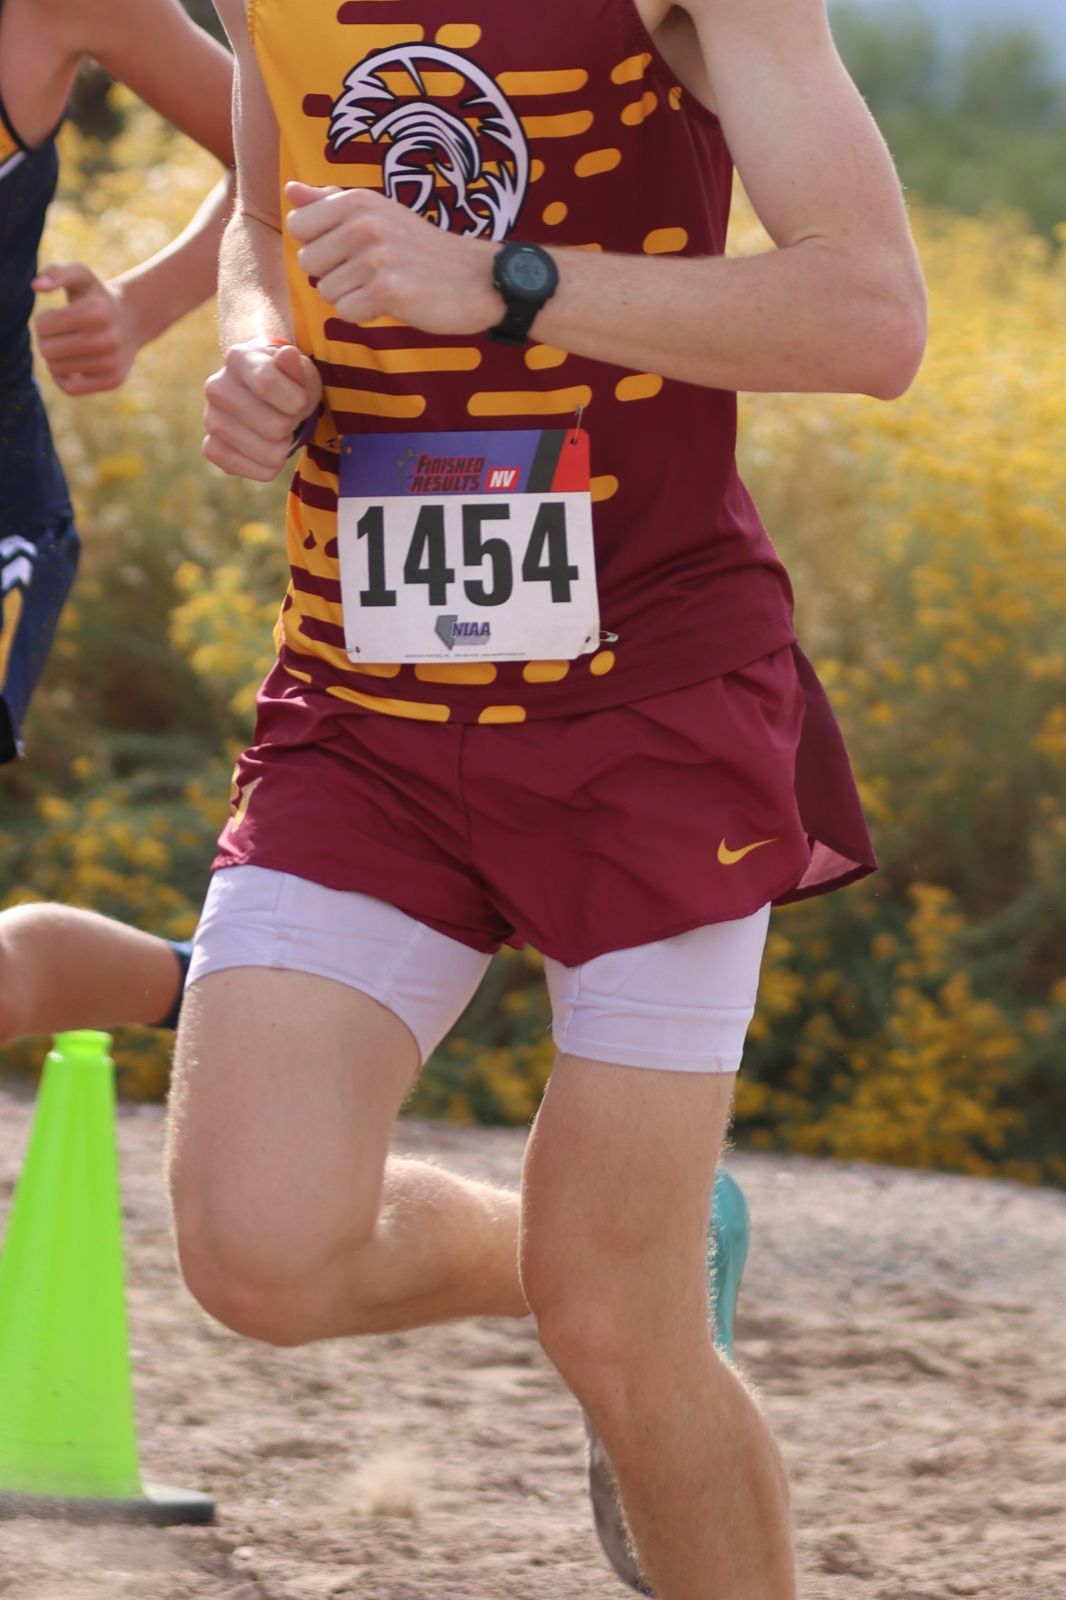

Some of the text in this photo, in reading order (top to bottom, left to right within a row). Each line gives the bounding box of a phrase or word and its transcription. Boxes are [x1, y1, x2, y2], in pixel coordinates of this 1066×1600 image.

[410, 475, 482, 493] RESULTS
[489, 469, 517, 488] NV
[356, 502, 580, 607] 1454
[451, 620, 492, 638] NIAA
